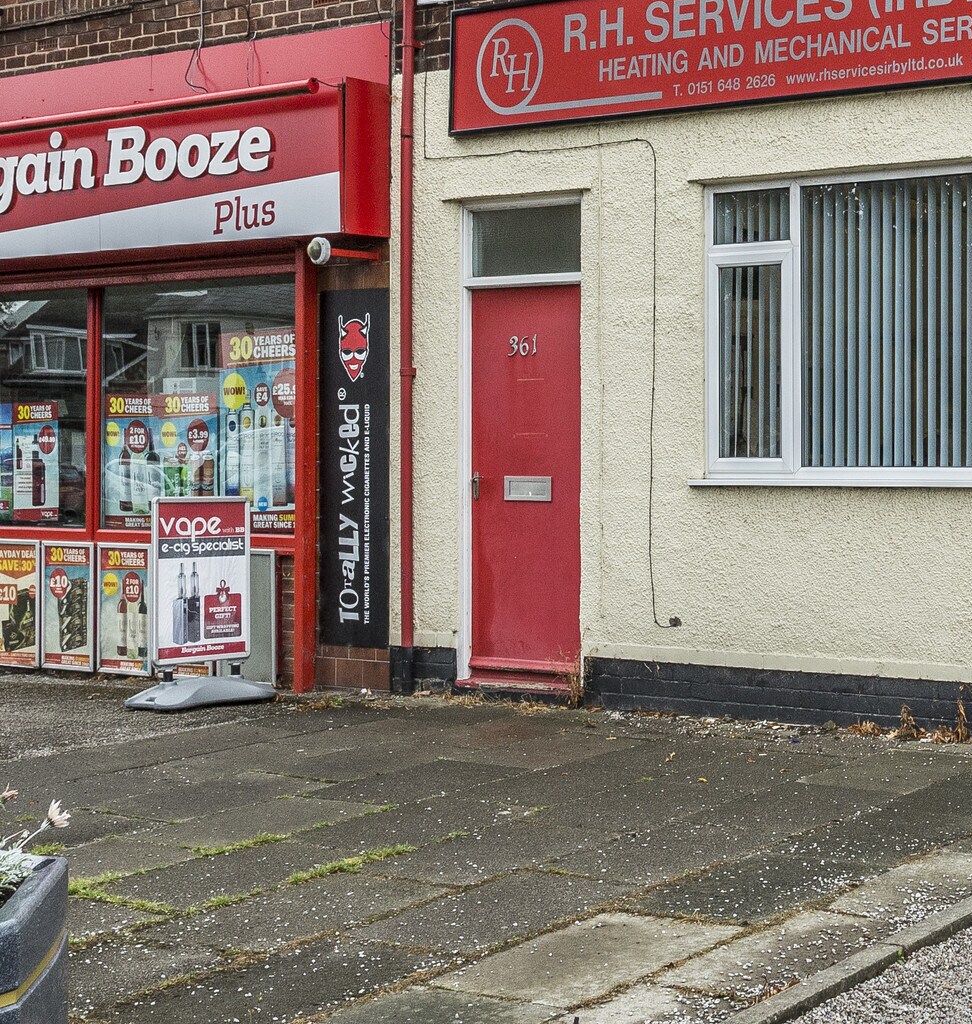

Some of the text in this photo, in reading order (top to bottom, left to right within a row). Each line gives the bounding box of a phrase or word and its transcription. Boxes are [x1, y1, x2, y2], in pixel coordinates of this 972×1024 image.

[563, 6, 634, 53] R.H.
[598, 49, 689, 82] HEATING
[697, 43, 745, 71] AND
[755, 23, 911, 65] MECHANICAL
[673, 52, 964, 97] T. 0151 648 2626 www.rhservicesirbyltd.co.uk
[103, 126, 271, 187] Booze
[213, 196, 276, 235] Plus
[230, 333, 295, 360] 30 YEARS OF
[253, 344, 296, 358] CHEERS
[507, 334, 537, 357] 361
[224, 387, 245, 396] WOW!
[256, 392, 268, 402] £4
[110, 397, 124, 413] 30
[125, 405, 152, 414] CHEERS
[165, 397, 180, 413] 30
[181, 403, 209, 412] CHEERS
[18, 405, 30, 420] 30
[30, 411, 52, 419] CHEERS
[130, 435, 145, 444] £10
[188, 429, 208, 439] £3.99
[160, 516, 221, 542] vape
[162, 537, 244, 555] e-cig specialist
[51, 547, 63, 562] 30
[108, 551, 120, 565] 30
[121, 558, 145, 566] CHEERS
[50, 575, 67, 588] £10
[126, 585, 139, 594] £10
[181, 645, 206, 654] Bargain
